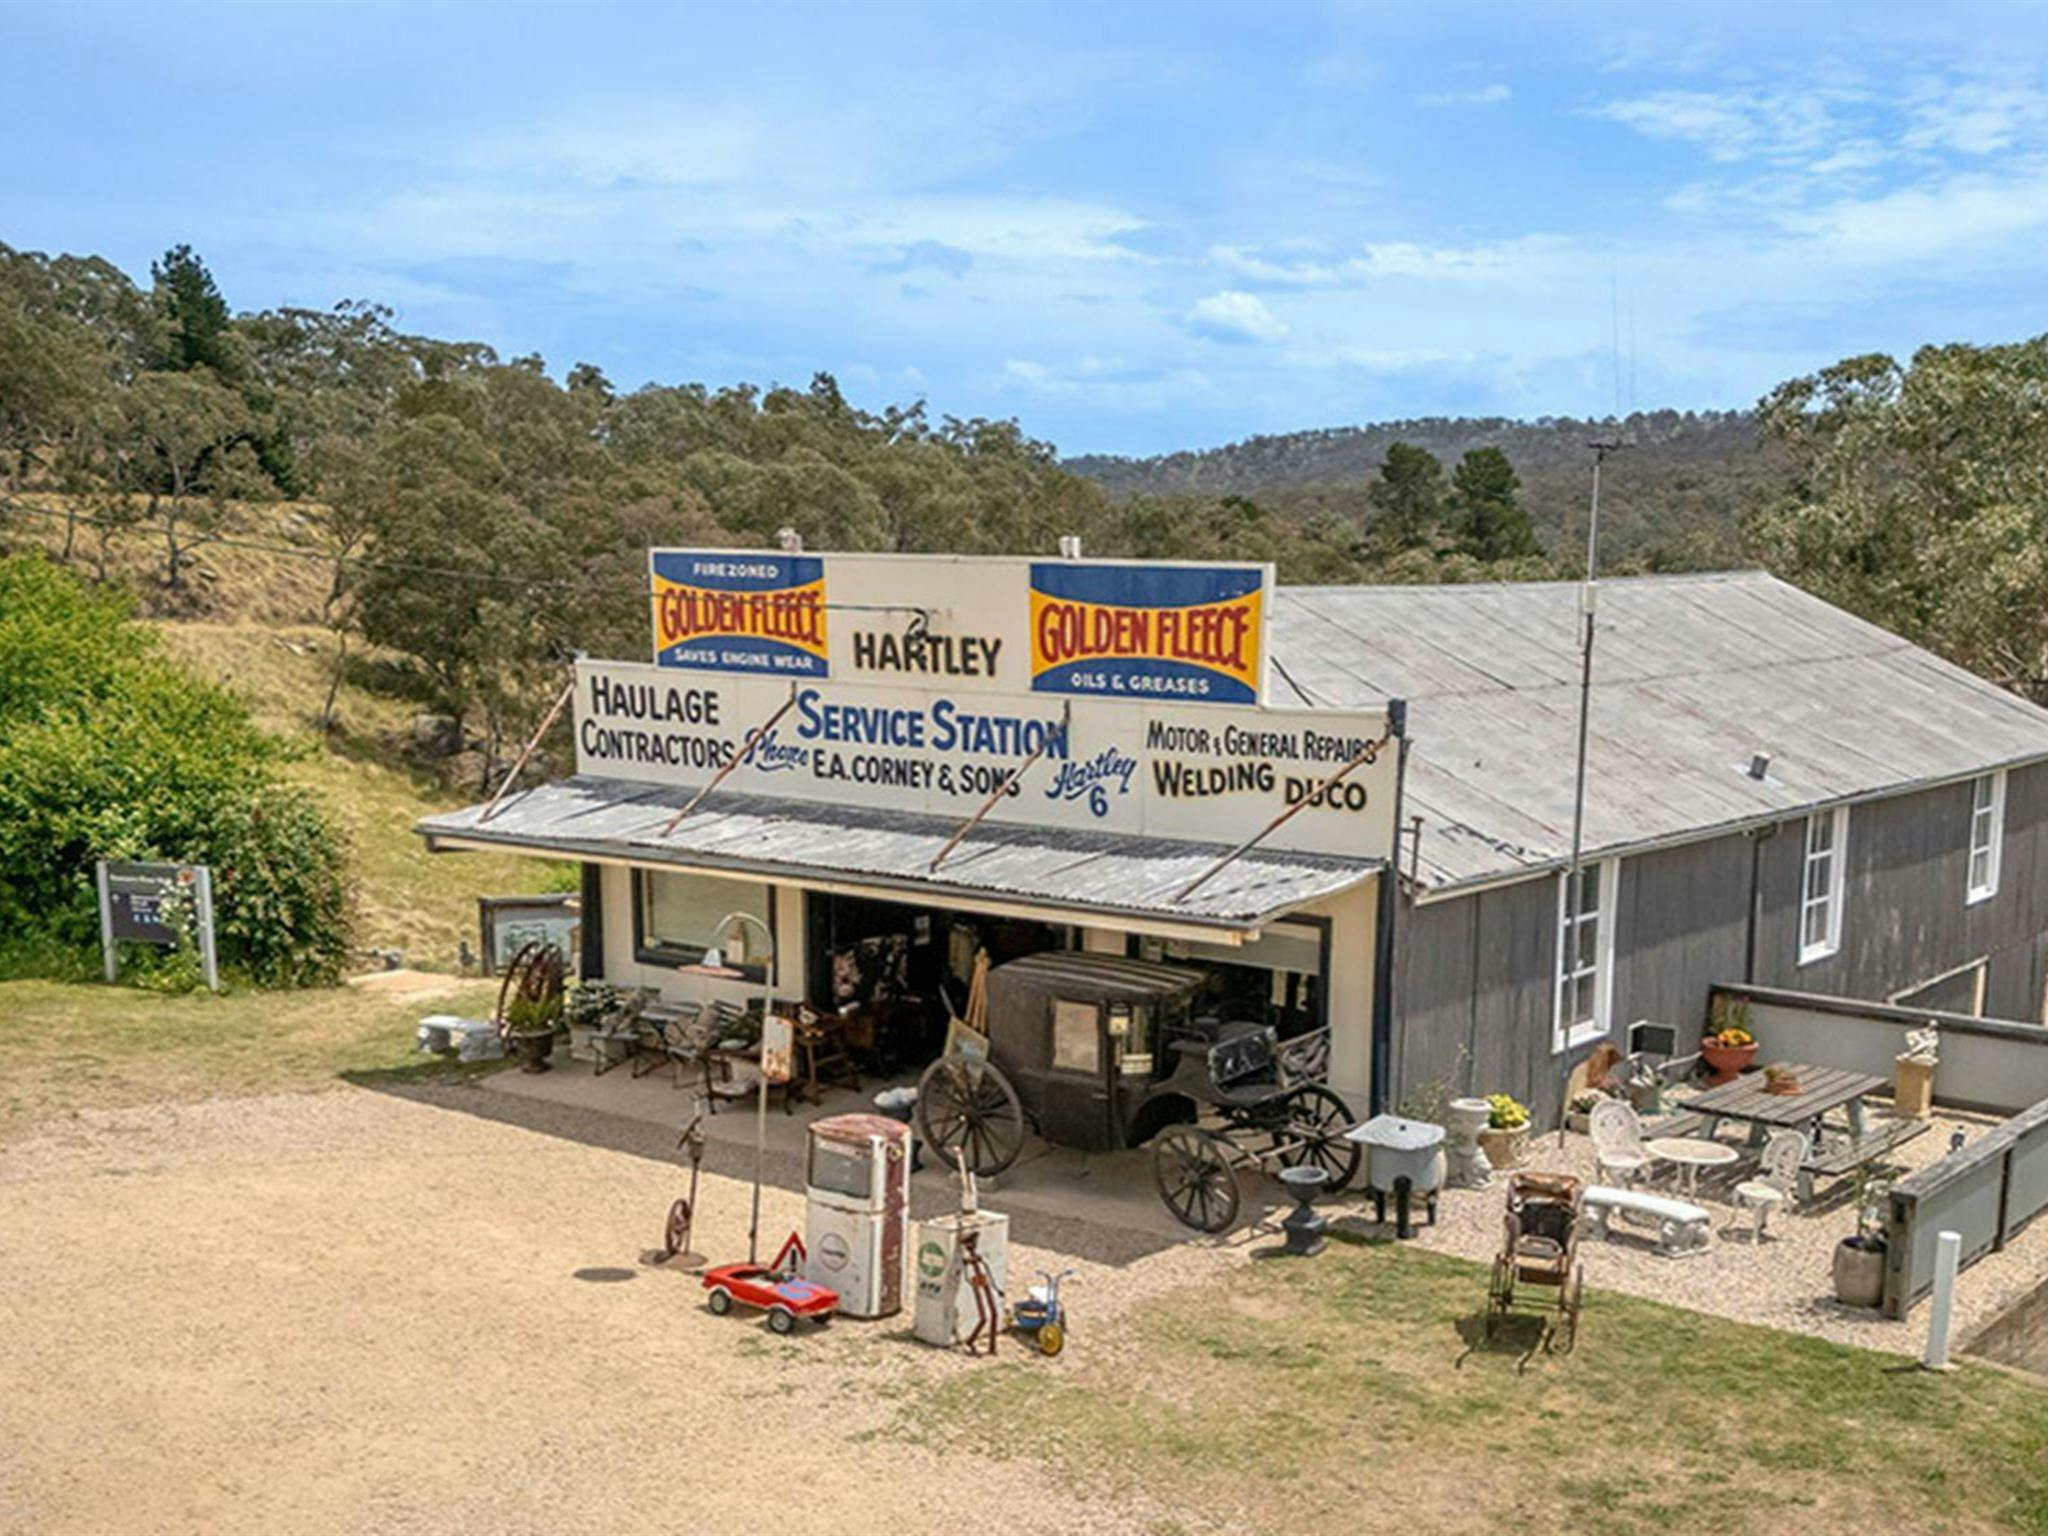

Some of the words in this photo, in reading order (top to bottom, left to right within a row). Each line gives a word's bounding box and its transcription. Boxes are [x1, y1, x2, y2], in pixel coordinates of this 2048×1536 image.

[661, 587, 745, 641] GOLDEN
[751, 590, 824, 646] FLEECE
[1039, 603, 1149, 663] GOLDEN
[1157, 605, 1251, 672] FLEECE
[675, 648, 717, 664] SAVES
[722, 651, 770, 667] ENGINE
[774, 655, 813, 669] WEAR
[853, 631, 1002, 677] HARTLEY
[590, 676, 719, 725] HAULAGE
[1071, 673, 1106, 689] OILS
[1112, 675, 1124, 690] &
[1129, 676, 1210, 695] GREASES
[581, 718, 735, 769] CONTRACTORS
[797, 688, 925, 749] SERVICE
[931, 699, 1069, 760] STATION
[1147, 720, 1210, 753] MOTOR
[1213, 736, 1221, 756] &
[1224, 725, 1299, 759] GENERAL
[1303, 730, 1377, 764] REPAIRS
[744, 728, 808, 769] Phone
[938, 764, 957, 795] &
[960, 764, 1021, 797] SONS
[1045, 747, 1137, 799] Hartley
[1153, 760, 1275, 797] WELDING
[1285, 777, 1367, 811] DUCO
[1089, 785, 1109, 818] 6
